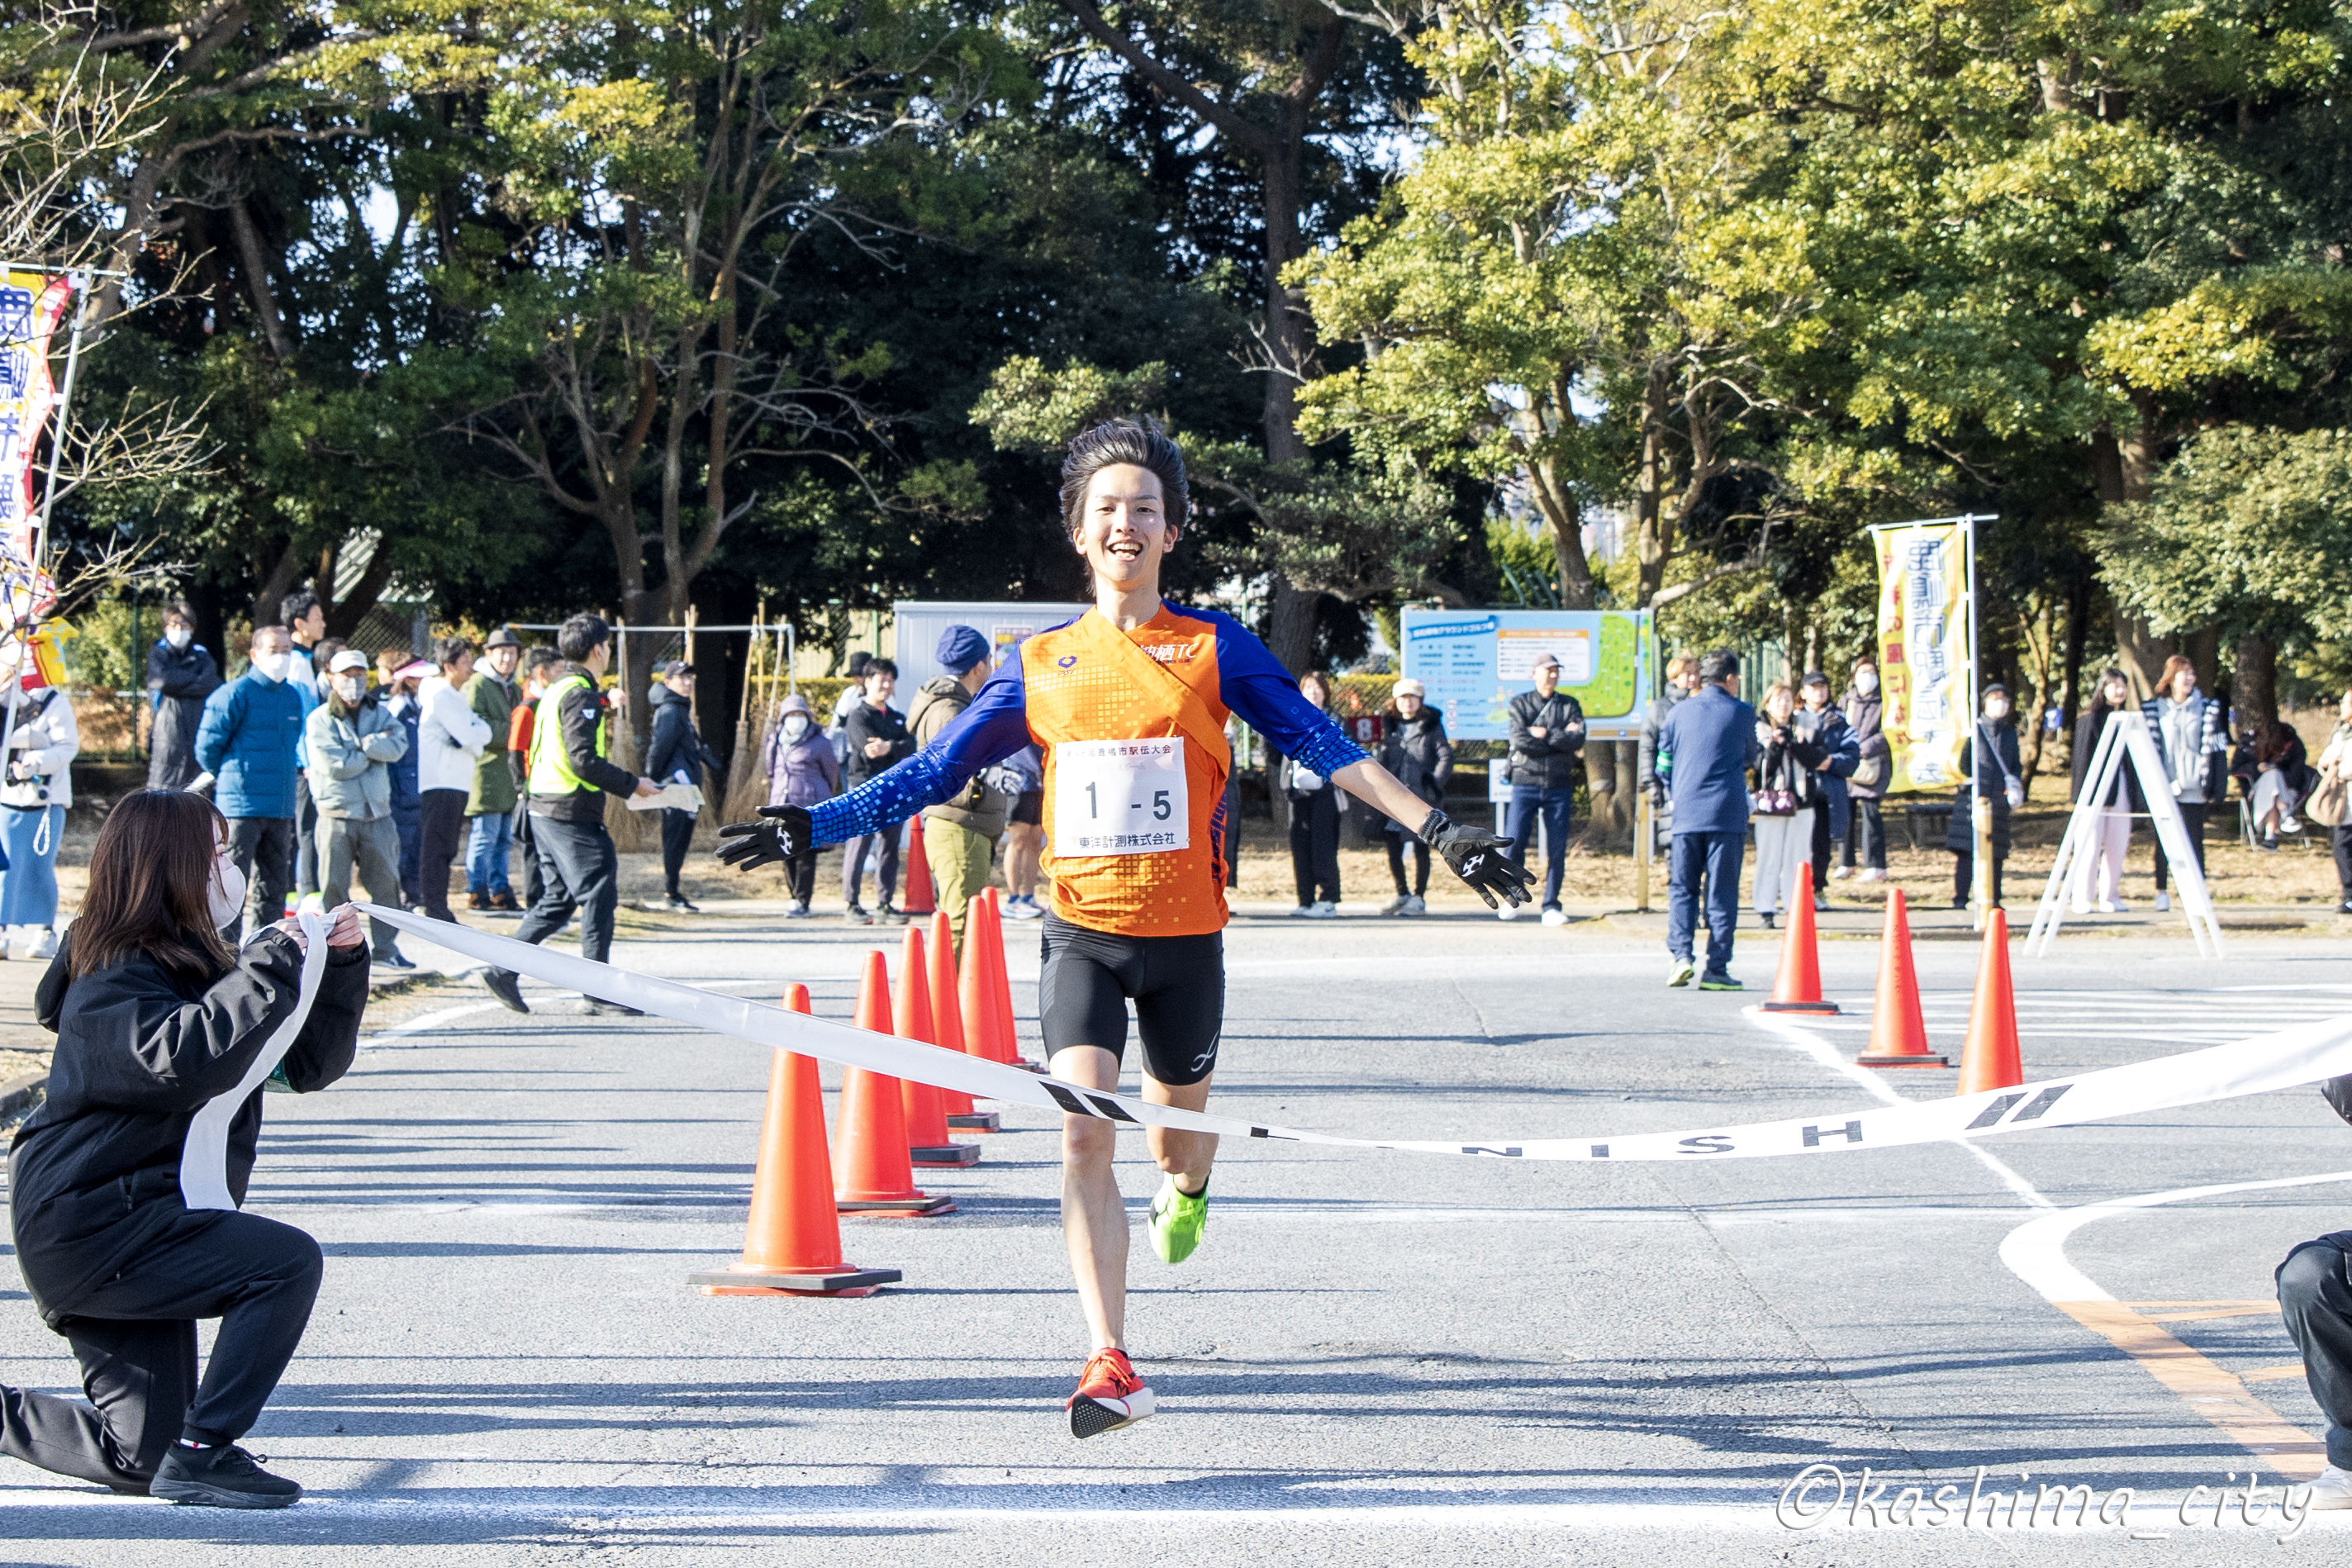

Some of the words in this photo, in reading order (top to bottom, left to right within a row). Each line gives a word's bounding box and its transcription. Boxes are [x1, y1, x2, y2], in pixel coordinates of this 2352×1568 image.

[1079, 832, 1176, 848] 東洋計測株式会社
